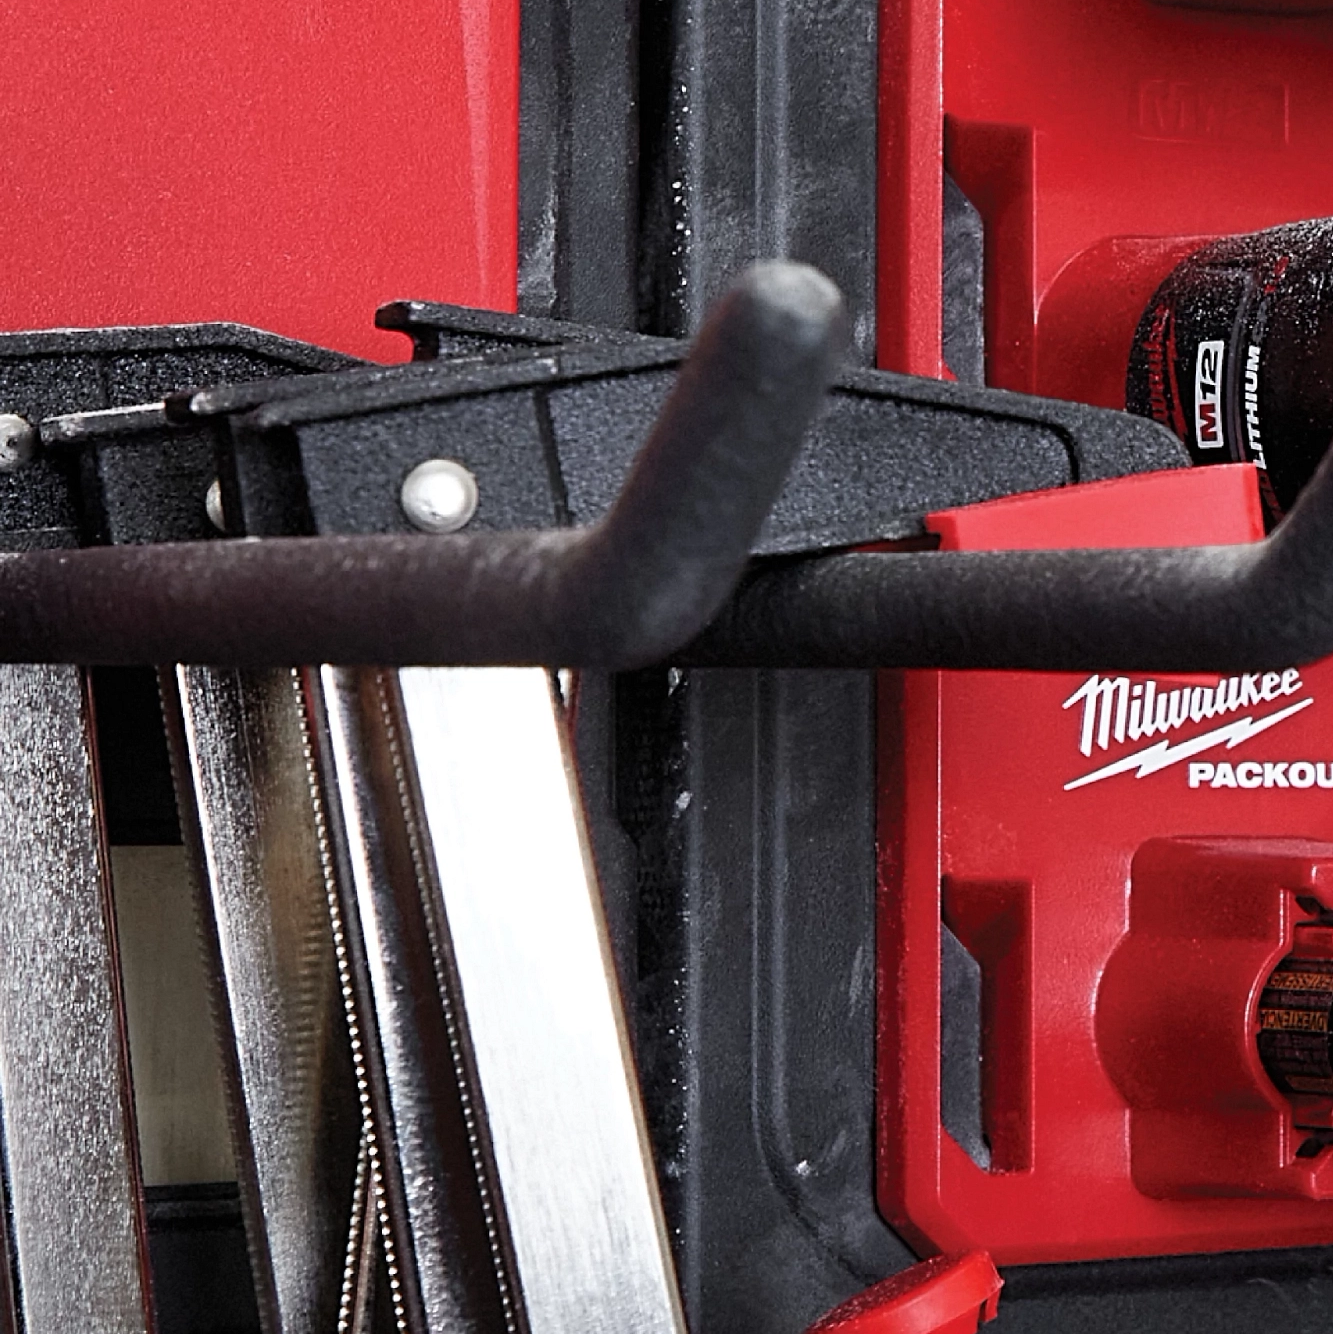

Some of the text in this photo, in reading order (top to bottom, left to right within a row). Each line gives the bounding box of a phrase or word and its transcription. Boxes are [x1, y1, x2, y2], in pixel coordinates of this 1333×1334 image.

[1199, 348, 1217, 441] M12
[1245, 345, 1271, 471] LITHIUM
[1063, 668, 1303, 757] Milwaukee
